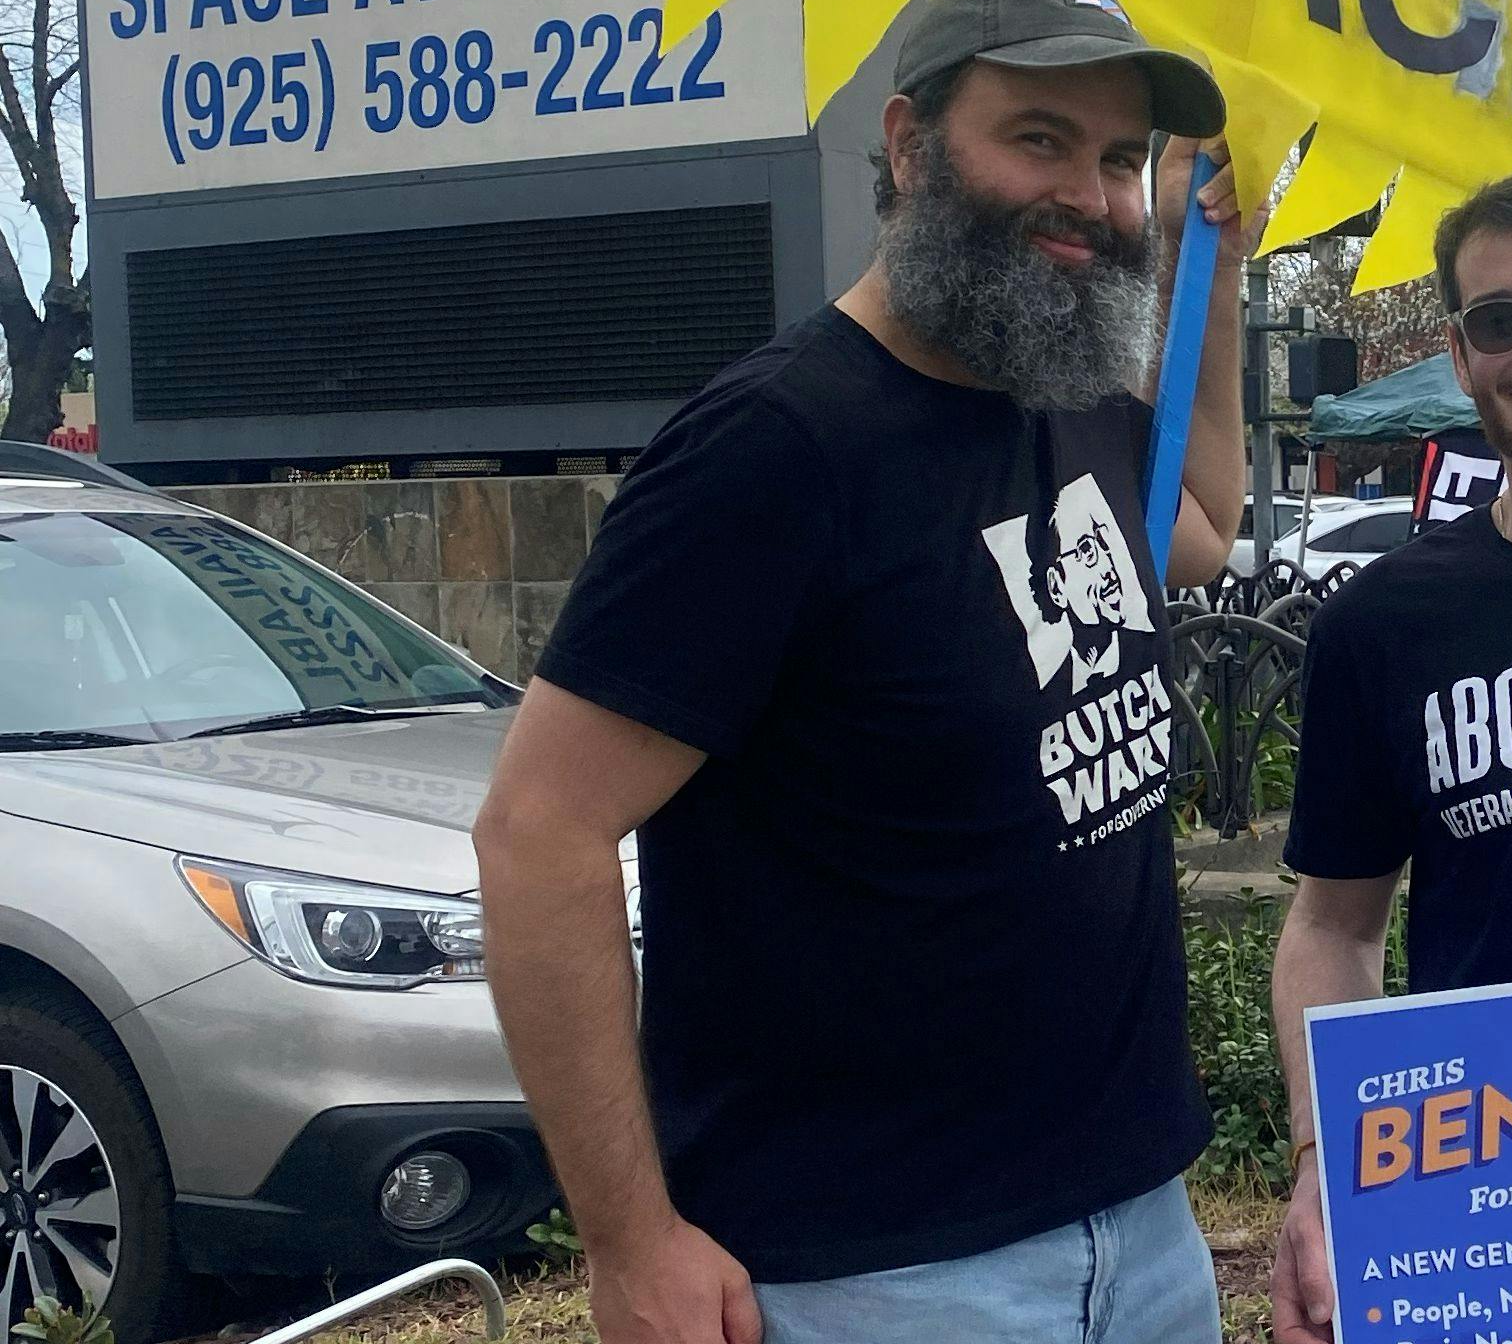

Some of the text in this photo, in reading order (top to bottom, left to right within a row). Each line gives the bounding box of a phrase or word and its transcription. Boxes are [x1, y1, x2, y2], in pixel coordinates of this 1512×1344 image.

[162, 8, 724, 164] (925) 588-2222
[1040, 664, 1171, 777] BUTCH
[1357, 1057, 1465, 1105] CHRIS
[1362, 1257, 1383, 1281] A
[1390, 1249, 1458, 1277] NEW
[1392, 1290, 1493, 1330] People,
